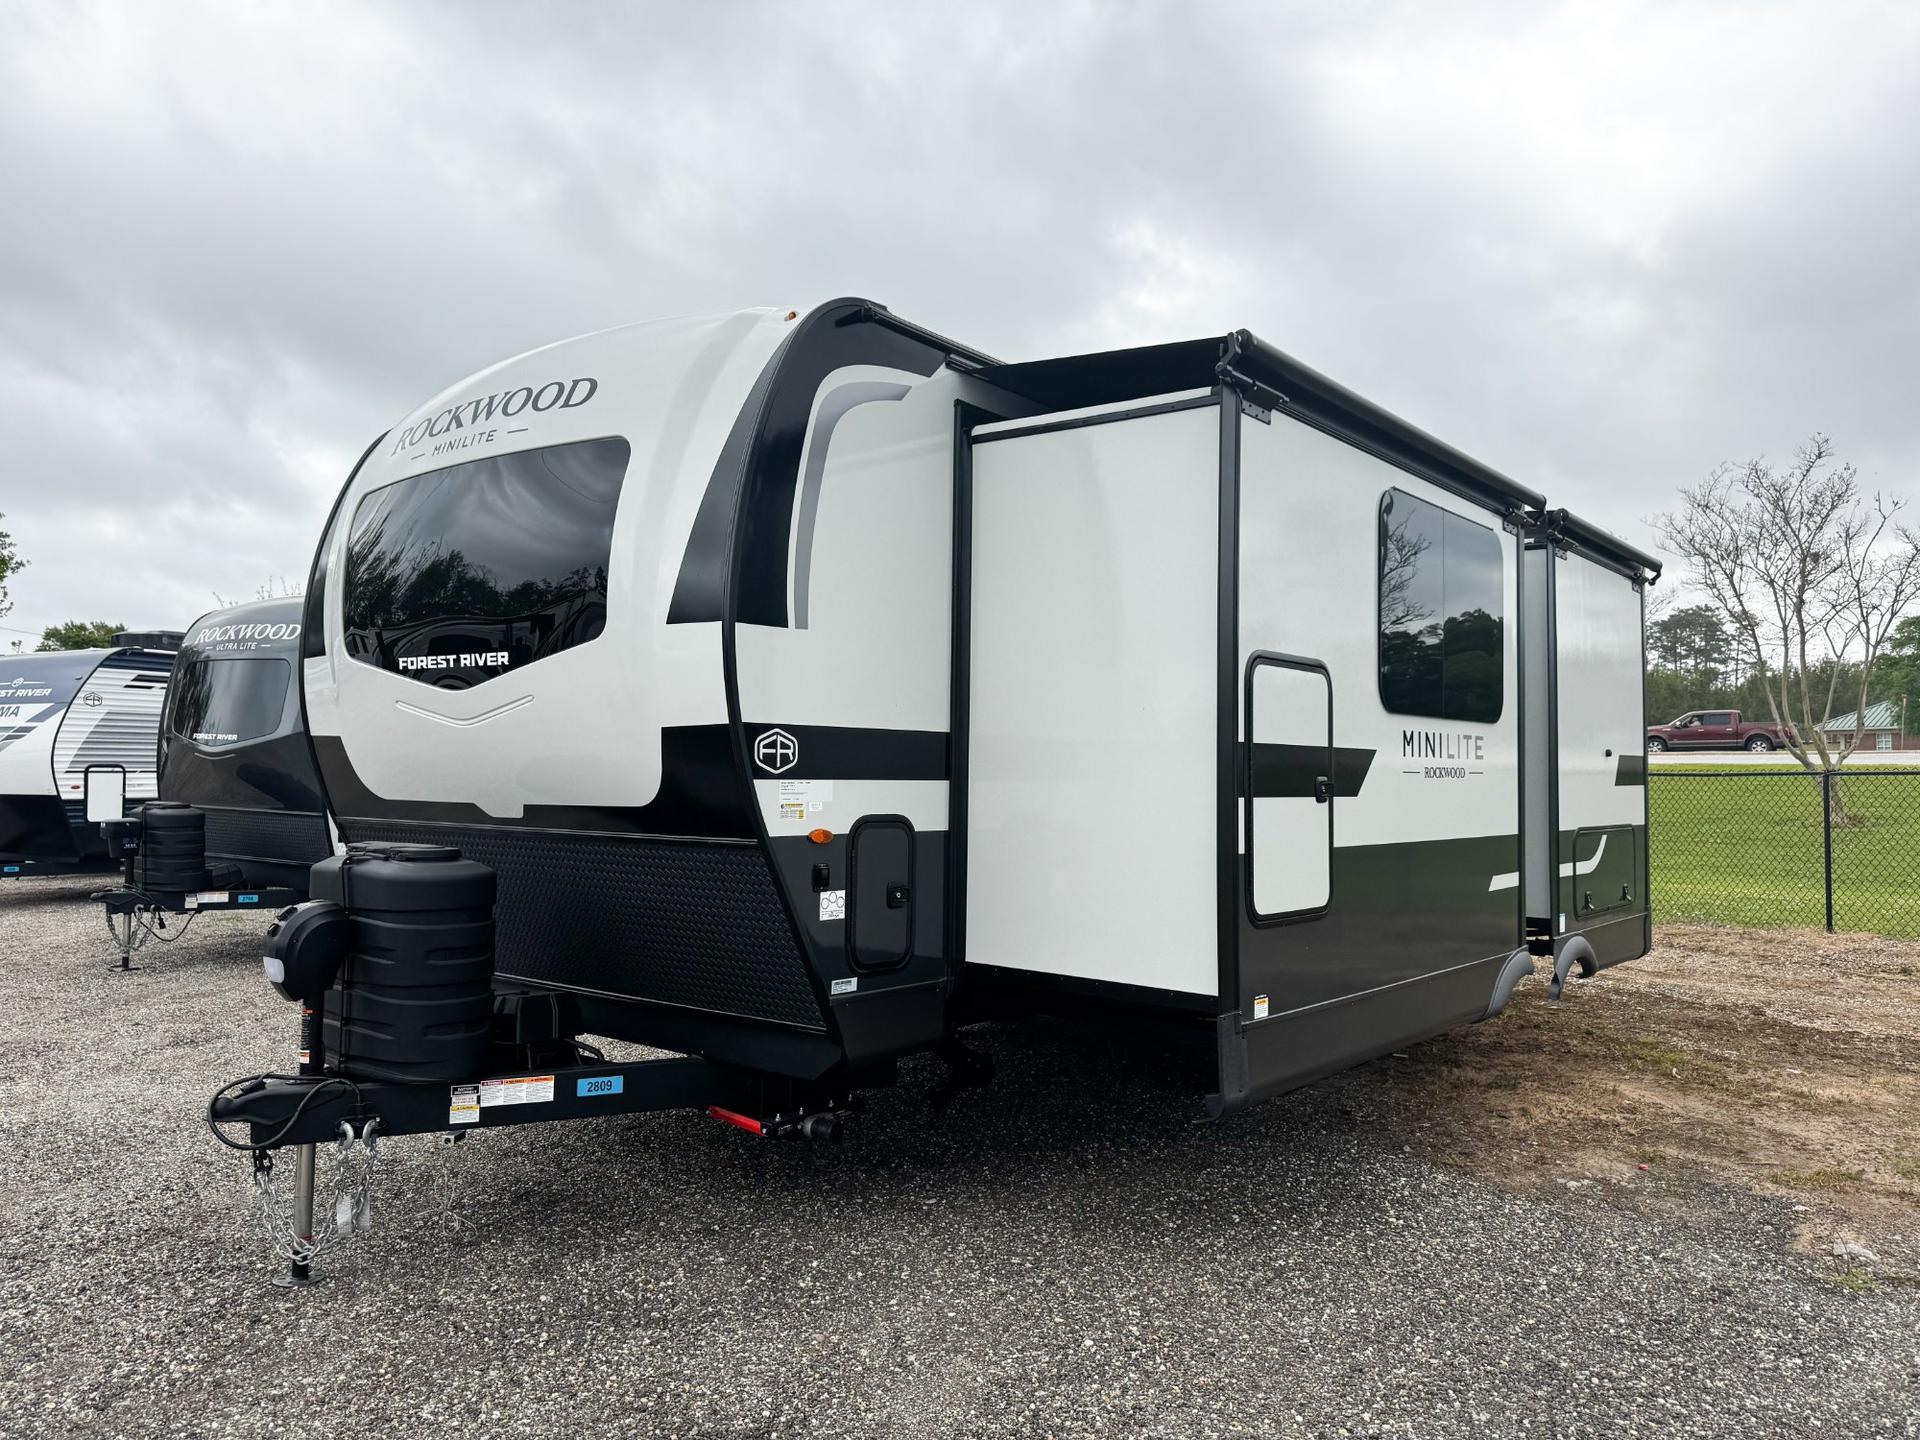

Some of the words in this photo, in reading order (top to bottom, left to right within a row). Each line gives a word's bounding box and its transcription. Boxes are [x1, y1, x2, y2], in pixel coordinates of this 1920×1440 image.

[390, 377, 598, 457] ROCKWOOD
[432, 429, 497, 456] MINILITE
[194, 623, 302, 644] ROCKWOOD
[216, 643, 237, 651] ULTRA
[239, 642, 258, 650] LITE
[398, 654, 456, 670] FOREST
[459, 651, 509, 667] RIVER
[15, 688, 53, 697] RIVER
[1403, 729, 1484, 760] MINILITE
[1424, 766, 1466, 778] ROCKWOOD
[586, 1080, 613, 1093] 2809
